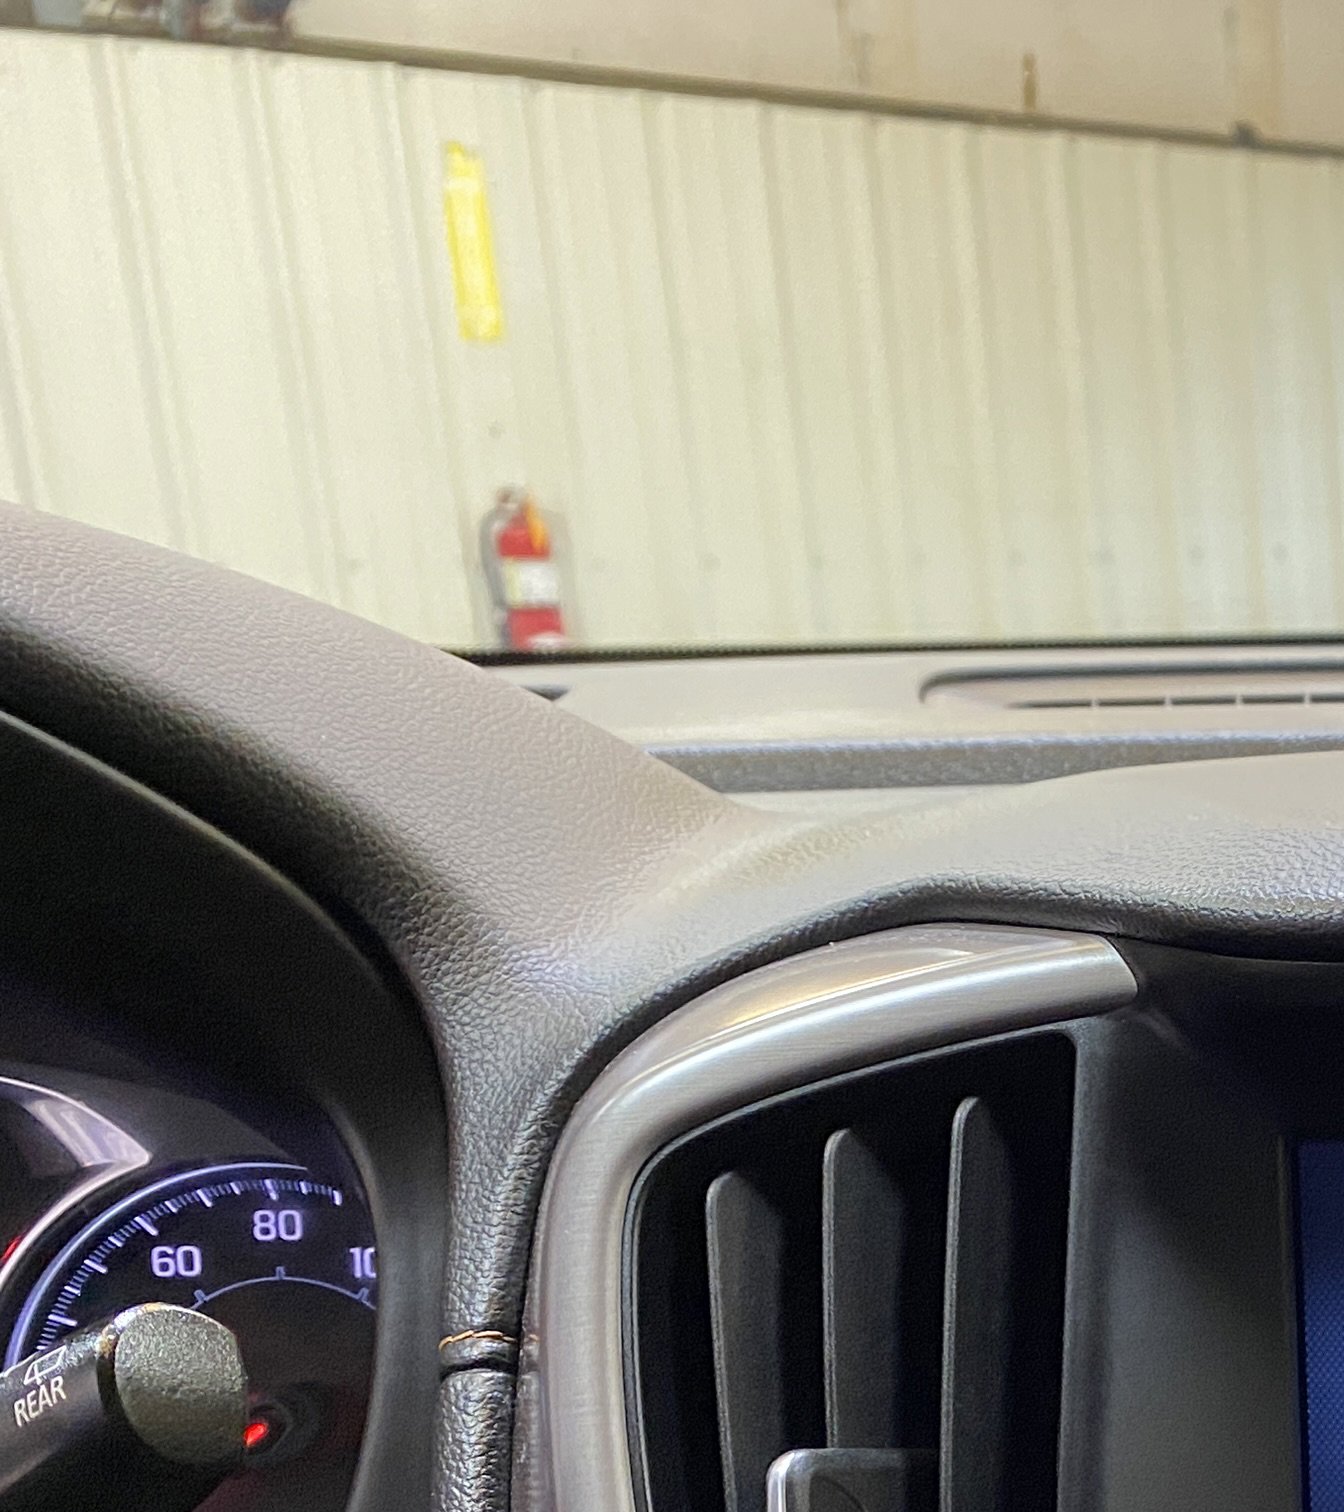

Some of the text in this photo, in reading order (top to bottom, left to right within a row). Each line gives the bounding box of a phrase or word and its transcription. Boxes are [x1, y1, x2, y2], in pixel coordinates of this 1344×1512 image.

[252, 1209, 303, 1242] 80
[150, 1245, 202, 1278] 60
[13, 1375, 67, 1428] REAR
